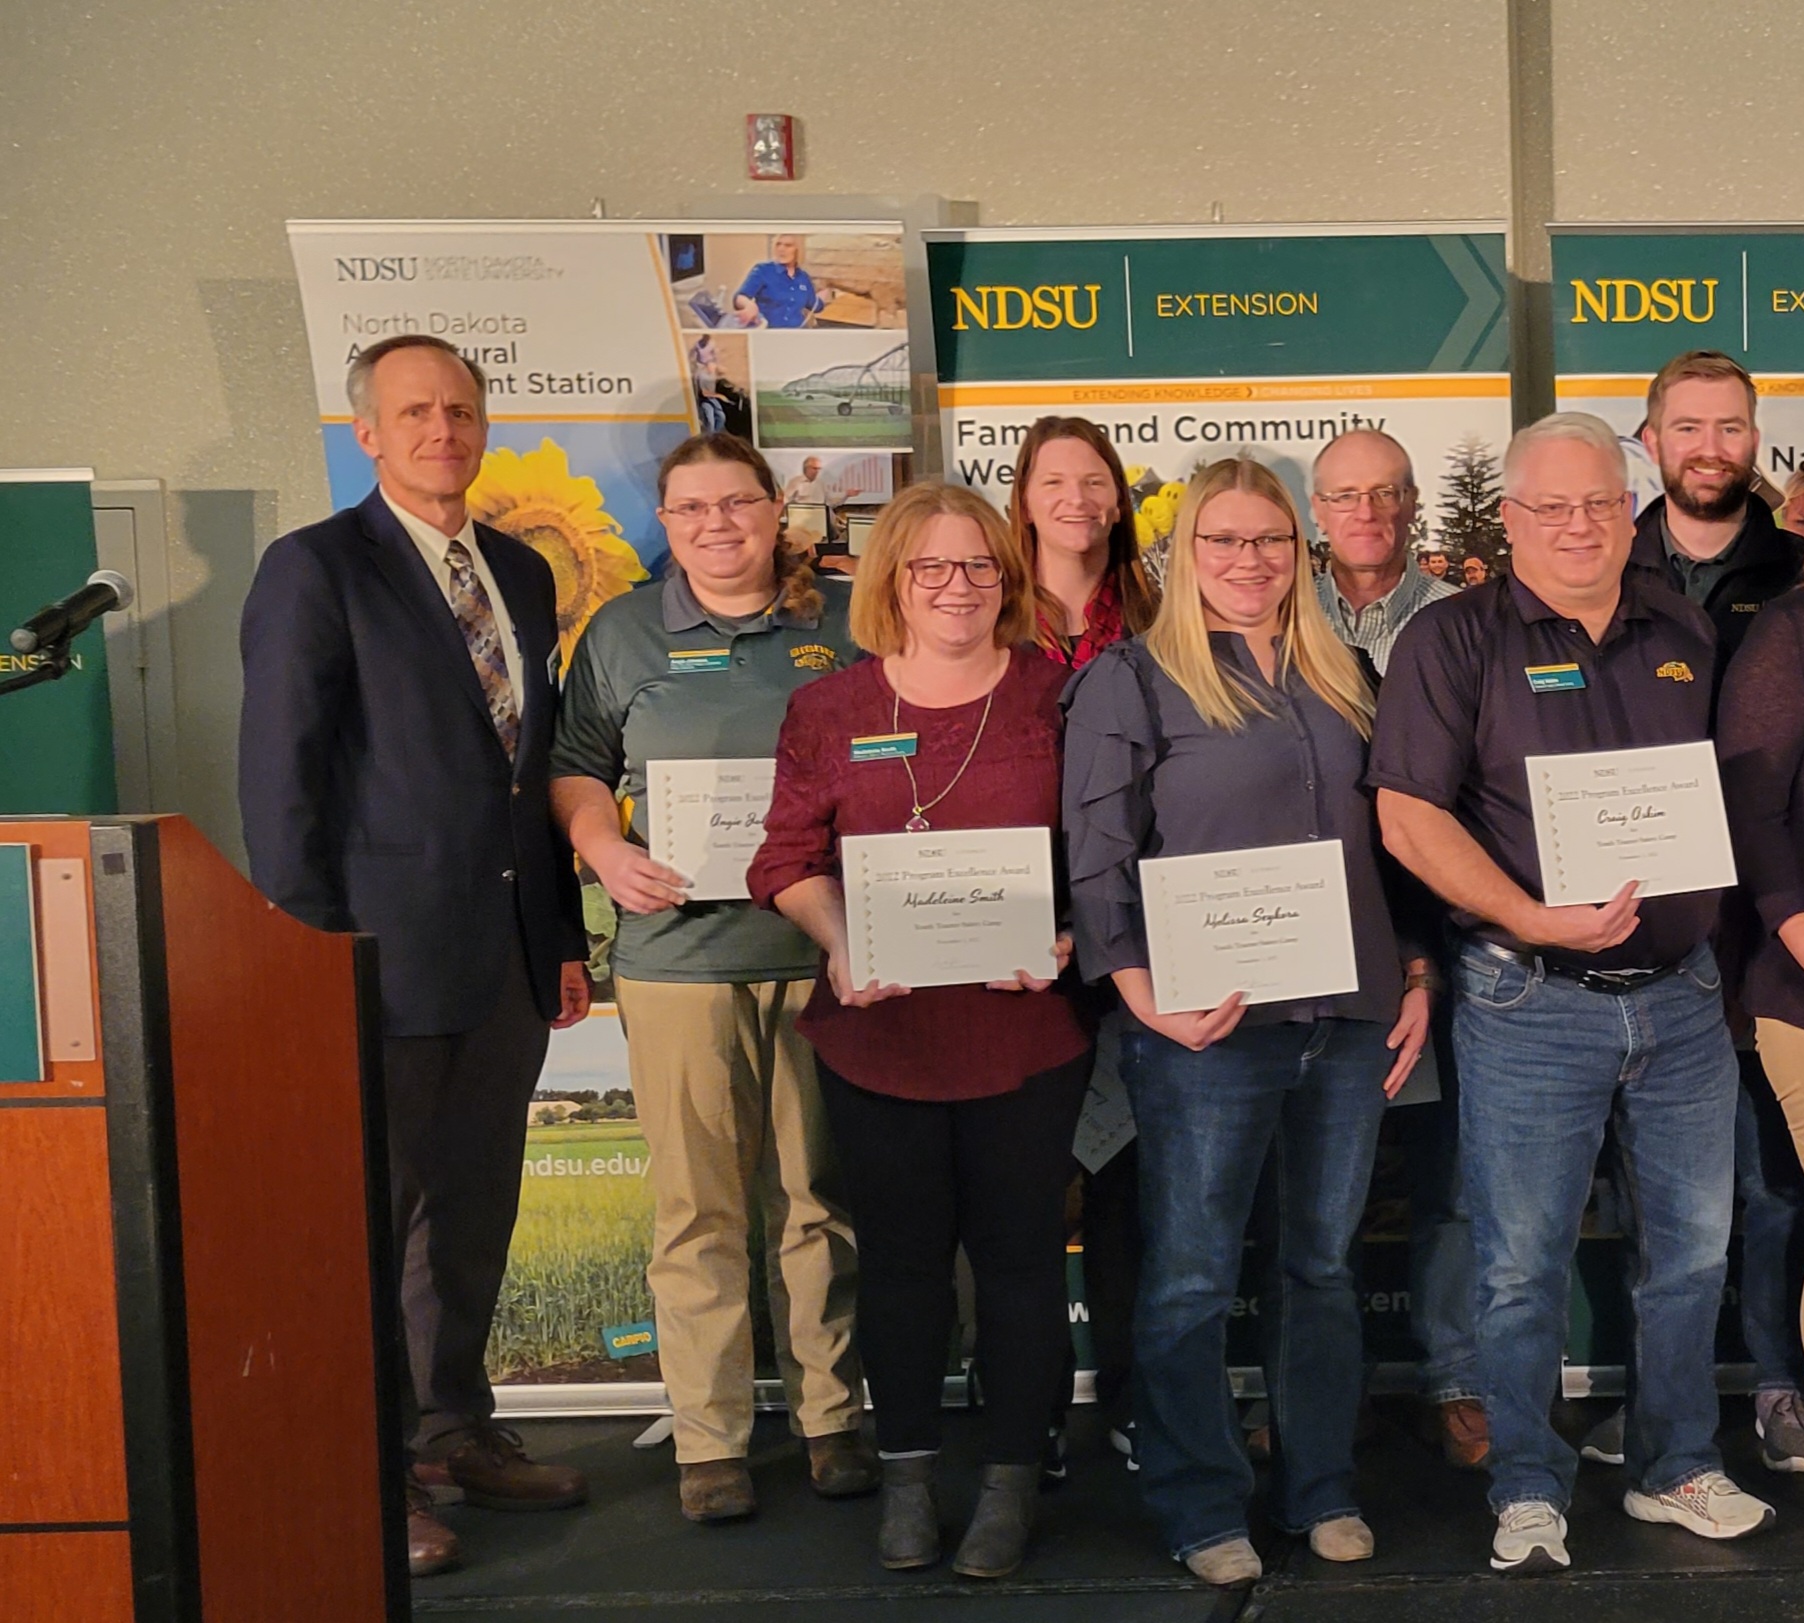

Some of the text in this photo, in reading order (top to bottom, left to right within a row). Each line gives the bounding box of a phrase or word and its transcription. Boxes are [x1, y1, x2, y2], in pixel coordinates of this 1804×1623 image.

[336, 257, 418, 282] NDSU
[423, 256, 545, 268] NORTH DAKOTA
[424, 267, 473, 281] STATE
[950, 284, 1319, 332] NDSU EXTENSION
[1570, 279, 1719, 323] NDSU
[343, 312, 528, 336] North Dakota
[527, 371, 634, 395] Station
[1073, 384, 1373, 401] EXTENDING KNOWLEDGE CHANGING LIVES
[957, 419, 1029, 447] Fam
[969, 888, 1005, 905] Smith
